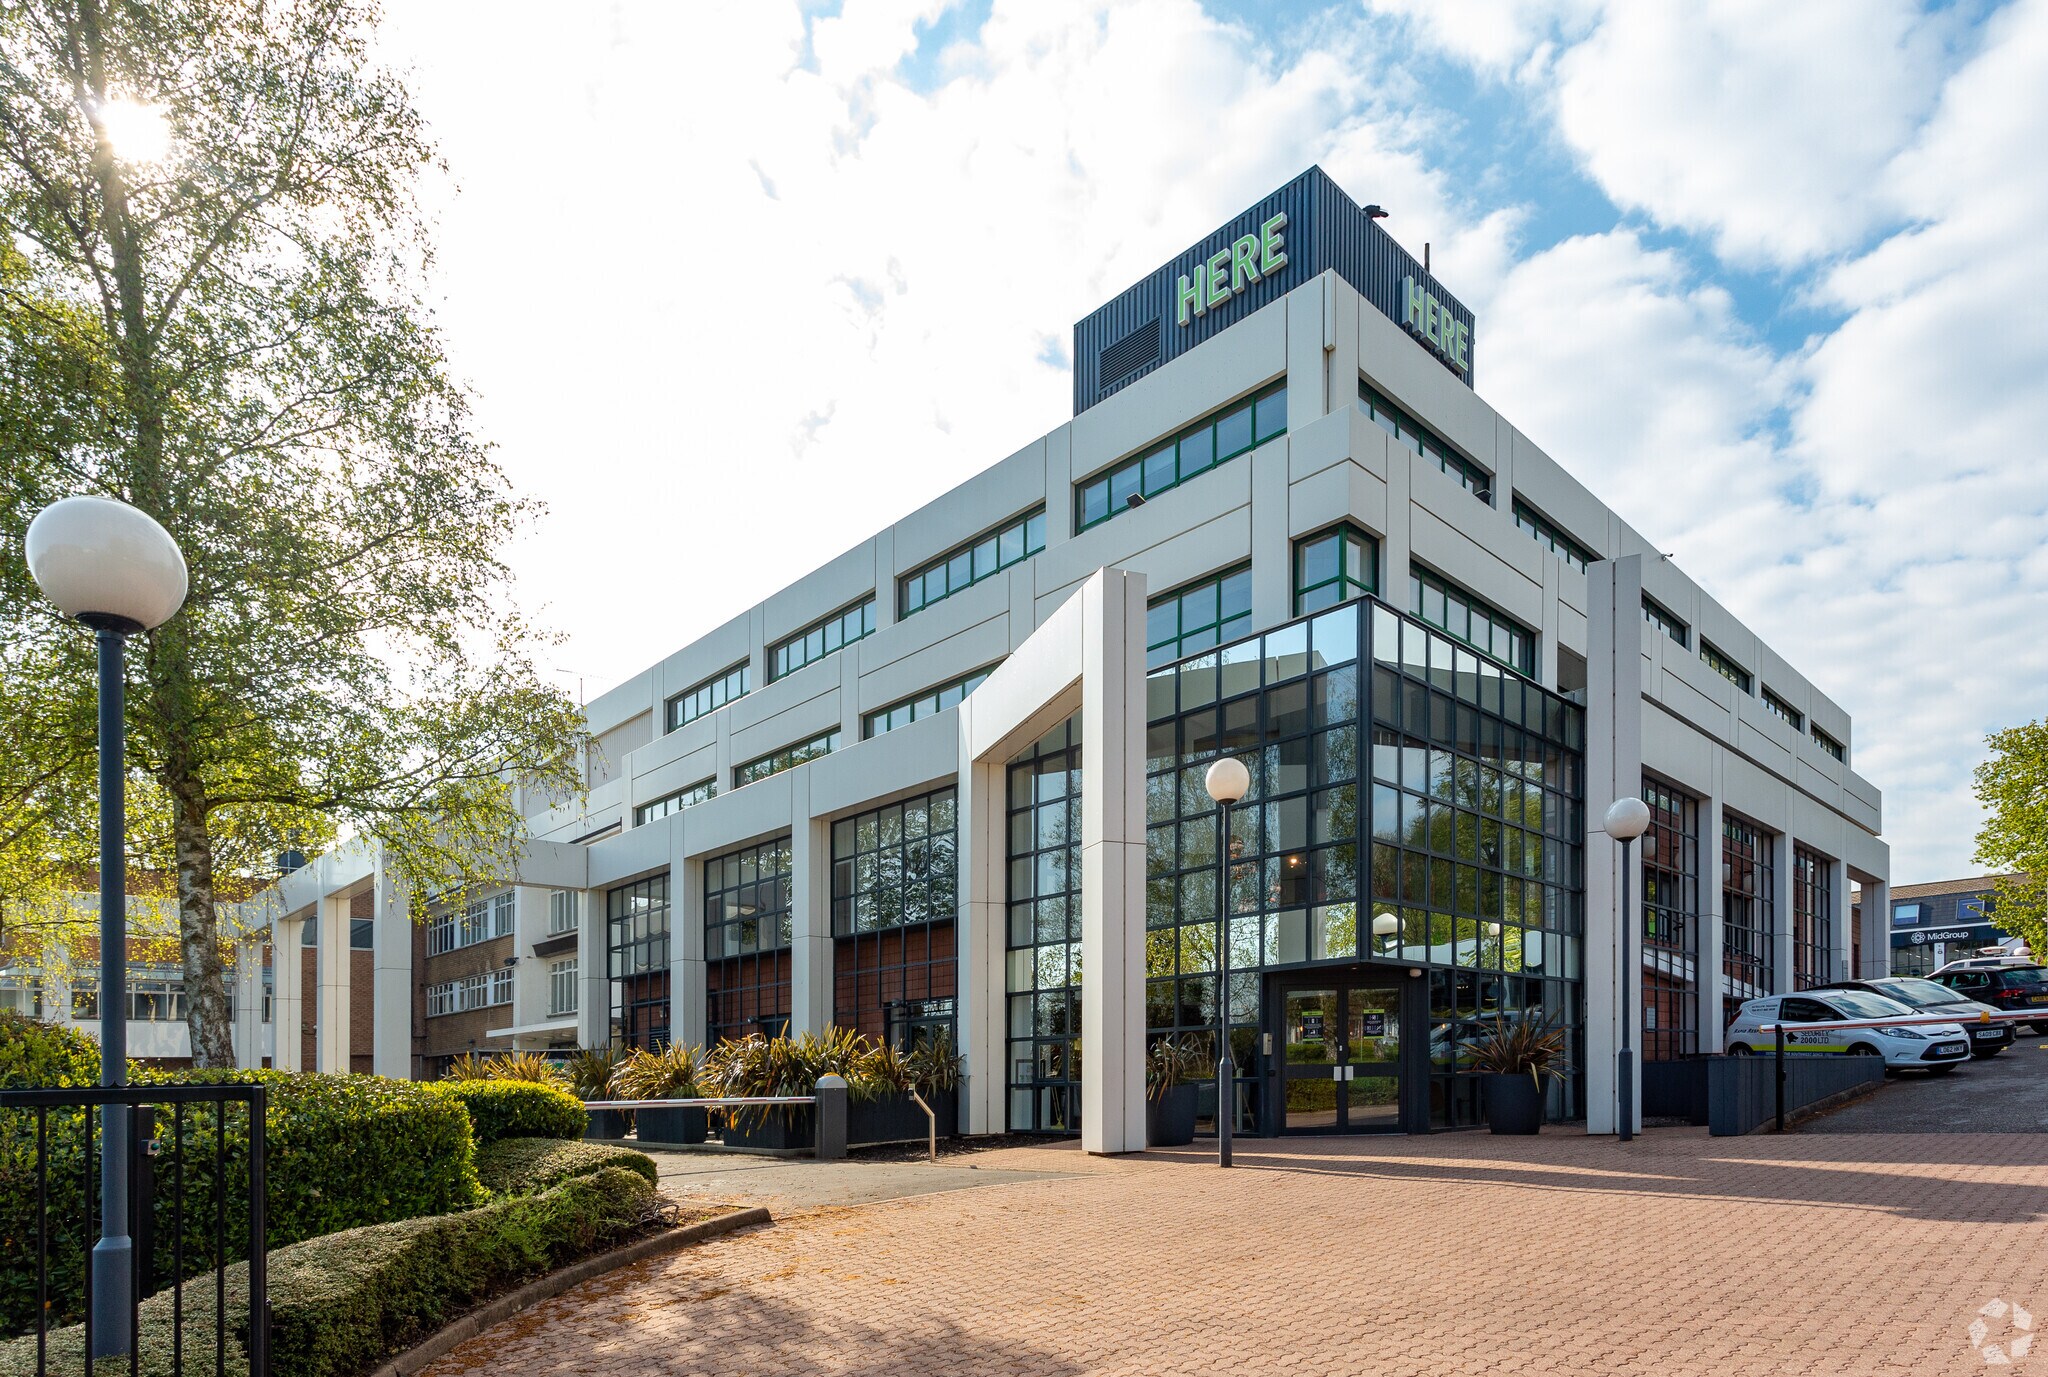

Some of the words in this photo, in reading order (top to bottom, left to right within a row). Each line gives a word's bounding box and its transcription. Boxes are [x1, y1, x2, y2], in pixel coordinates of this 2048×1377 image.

[1178, 211, 1288, 327] HERE
[1402, 275, 1468, 374] HERE
[1927, 931, 1969, 940] MidGroup
